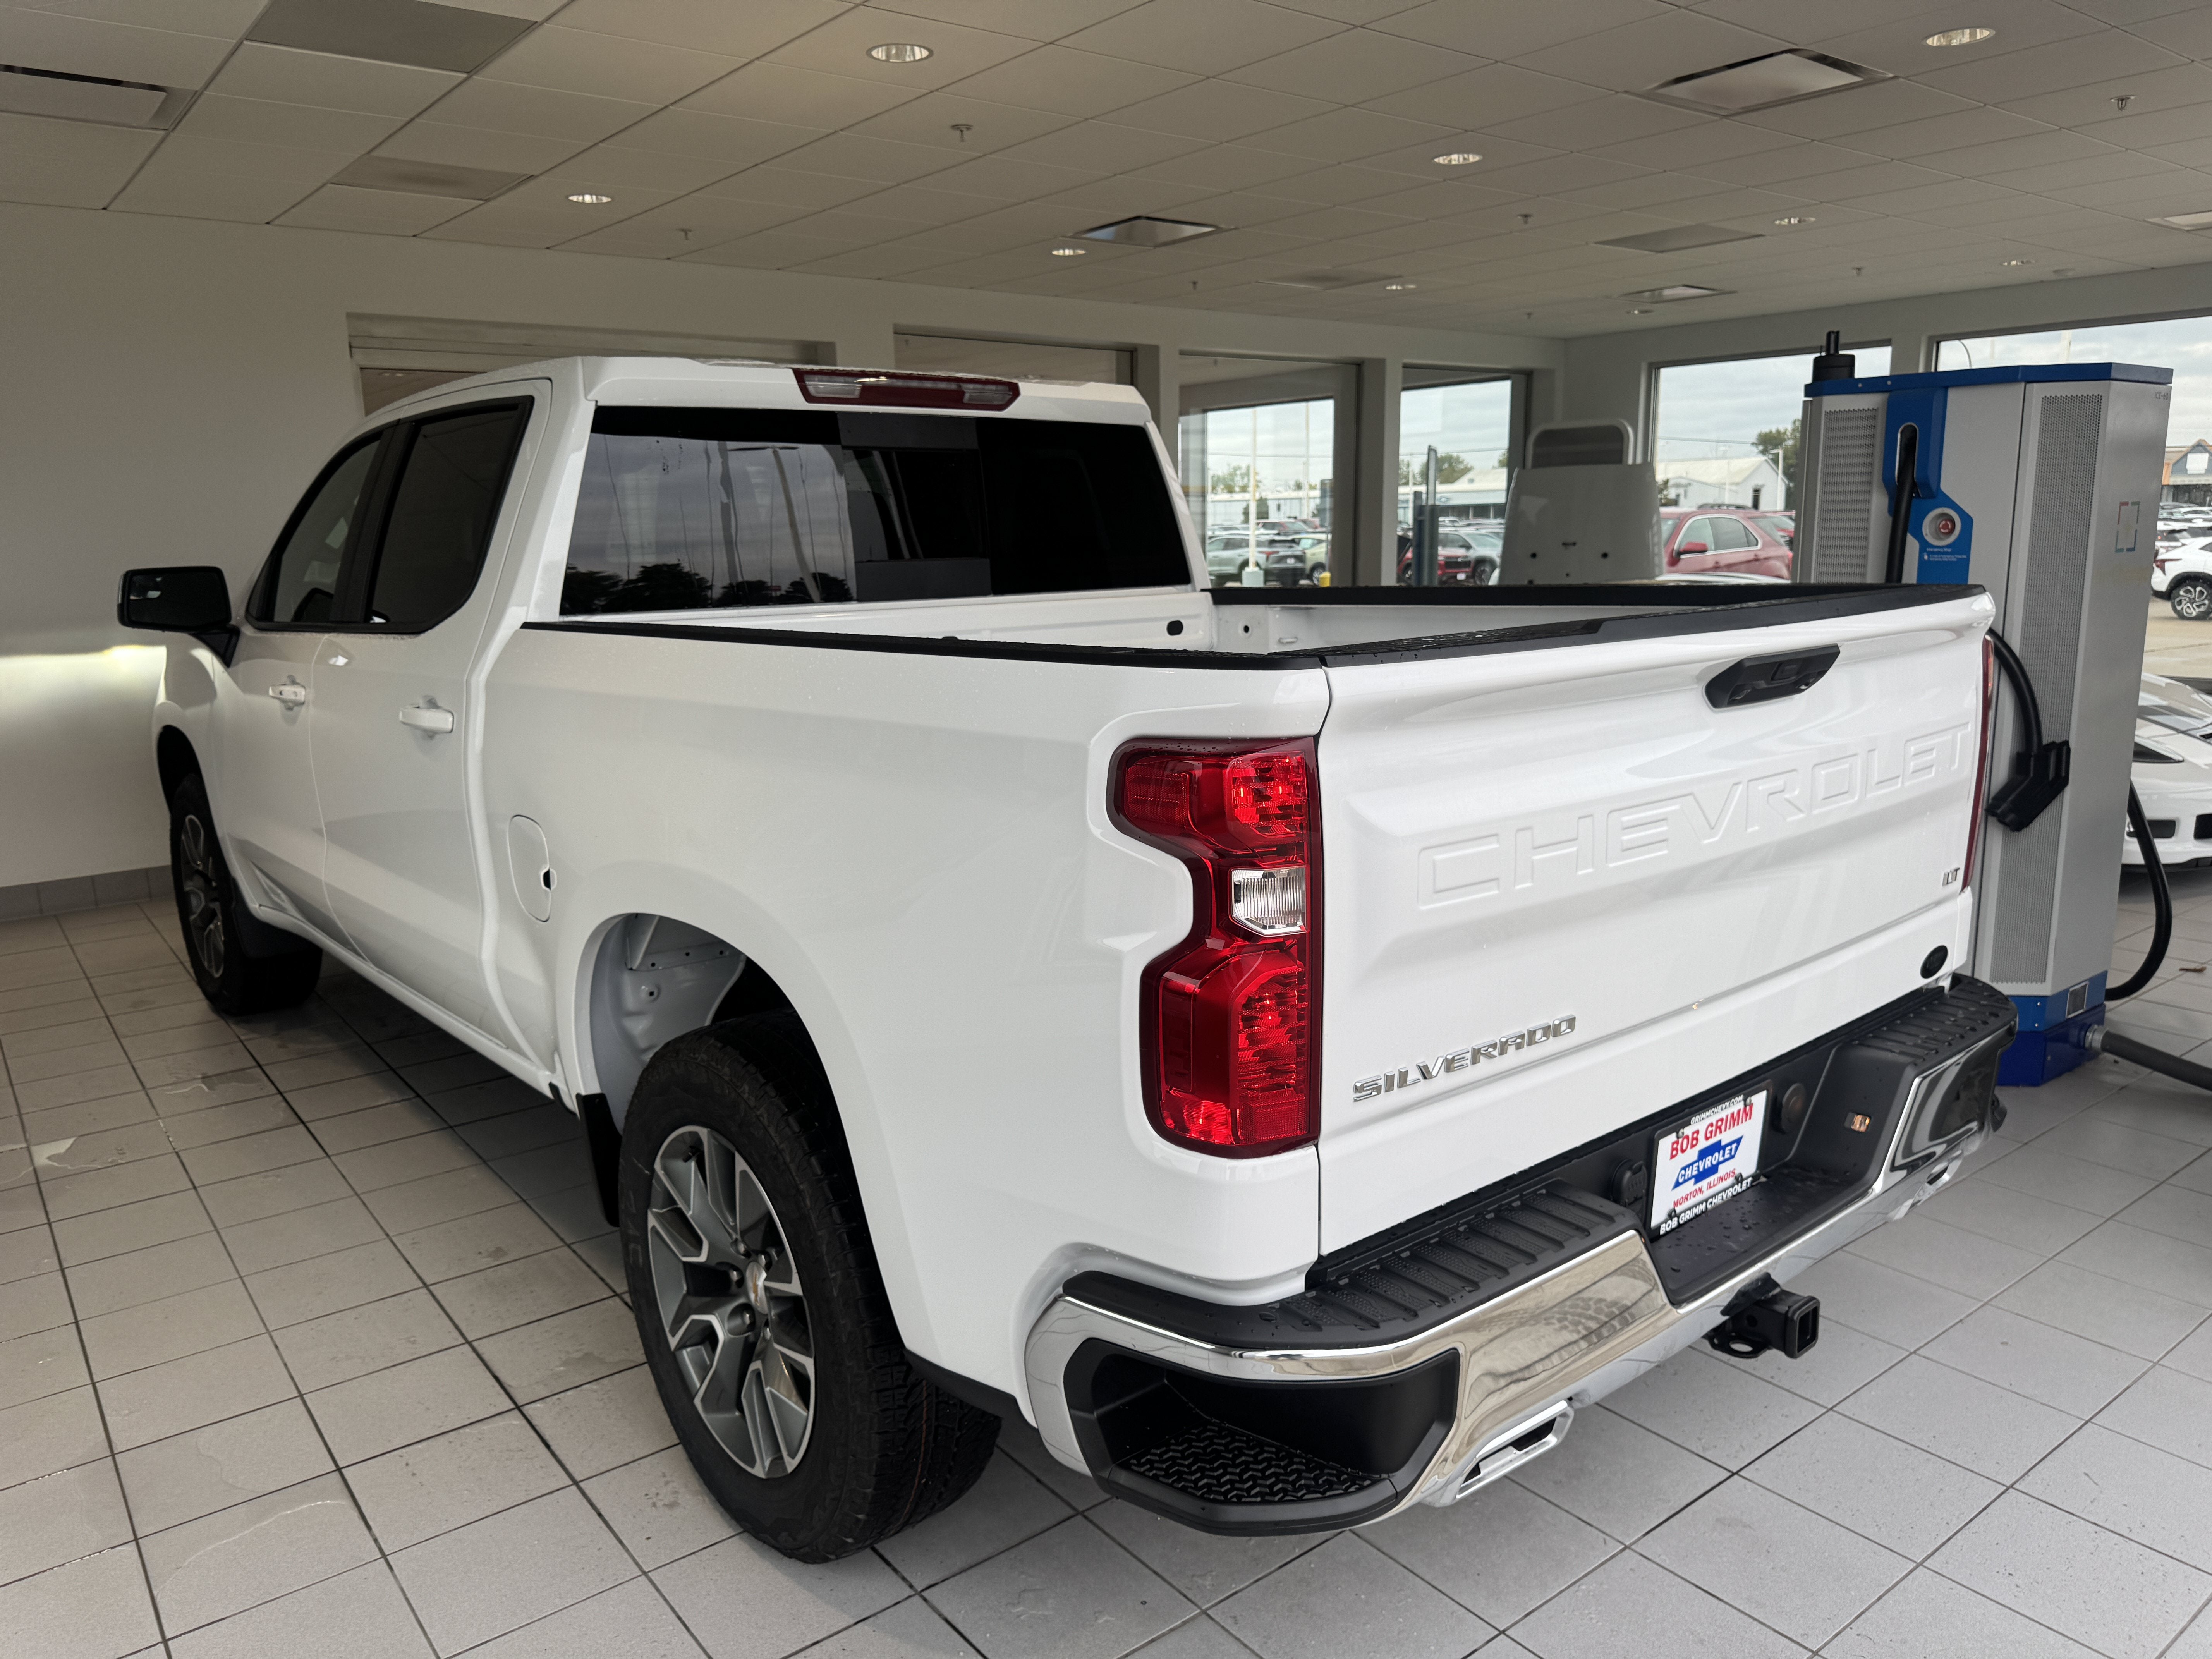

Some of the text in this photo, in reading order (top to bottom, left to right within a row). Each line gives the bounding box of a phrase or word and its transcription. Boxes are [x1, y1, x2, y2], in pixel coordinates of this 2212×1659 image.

[1417, 722, 1970, 910] CHEVROLET
[1942, 867, 1960, 886] LT
[1353, 1014, 1576, 1102] SILVERADO
[1669, 1103, 1753, 1160] BOB GRIMM
[1690, 1094, 1743, 1125] GRIMMCHEVY.COM
[1678, 1143, 1737, 1183] CHEVROLET
[1660, 1177, 1753, 1235] BOB GRIMM CHEVROLET
[1673, 1168, 1736, 1208] MORTON, ILLINOIS
